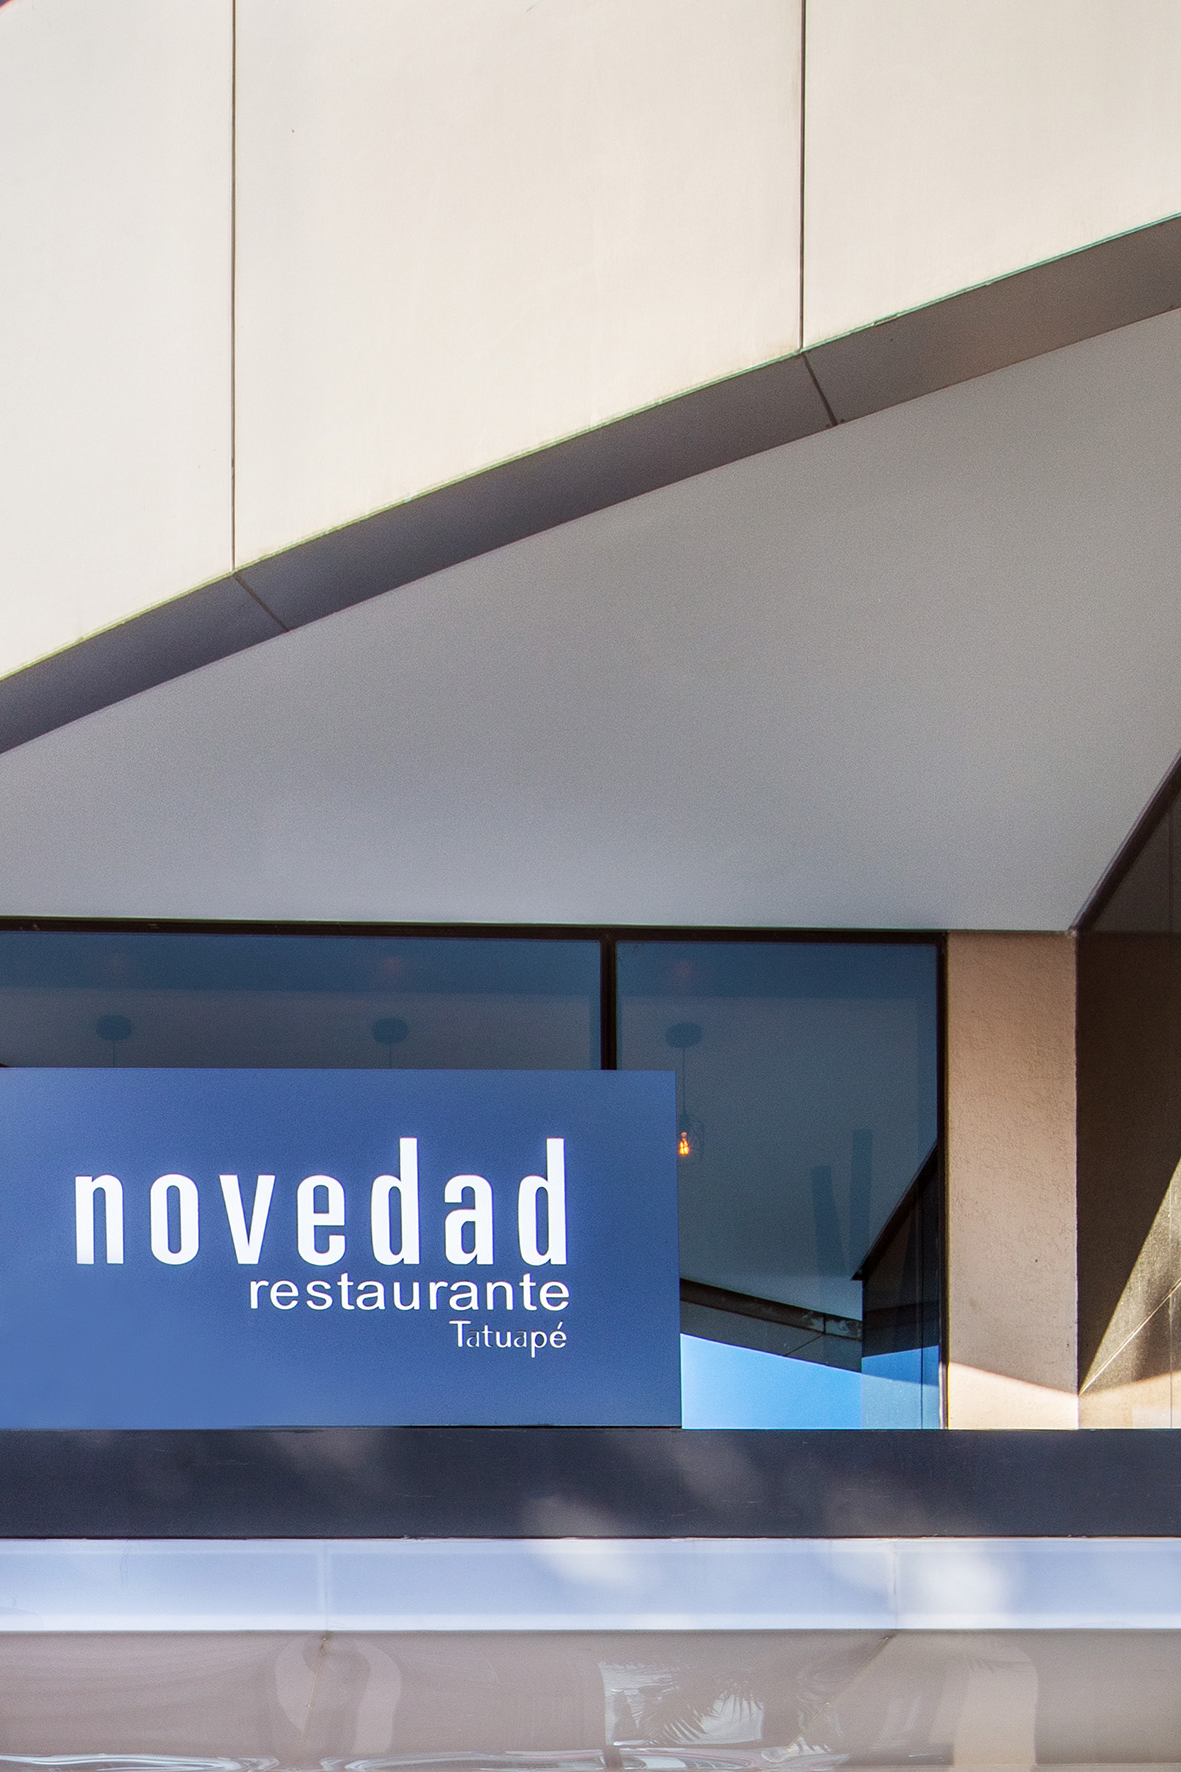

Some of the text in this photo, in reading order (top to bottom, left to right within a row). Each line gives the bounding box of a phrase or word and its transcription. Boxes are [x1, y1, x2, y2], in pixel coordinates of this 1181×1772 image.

[75, 1137, 568, 1266] novedad
[249, 1272, 571, 1312] restaurante
[448, 1320, 568, 1359] Tatuapé
